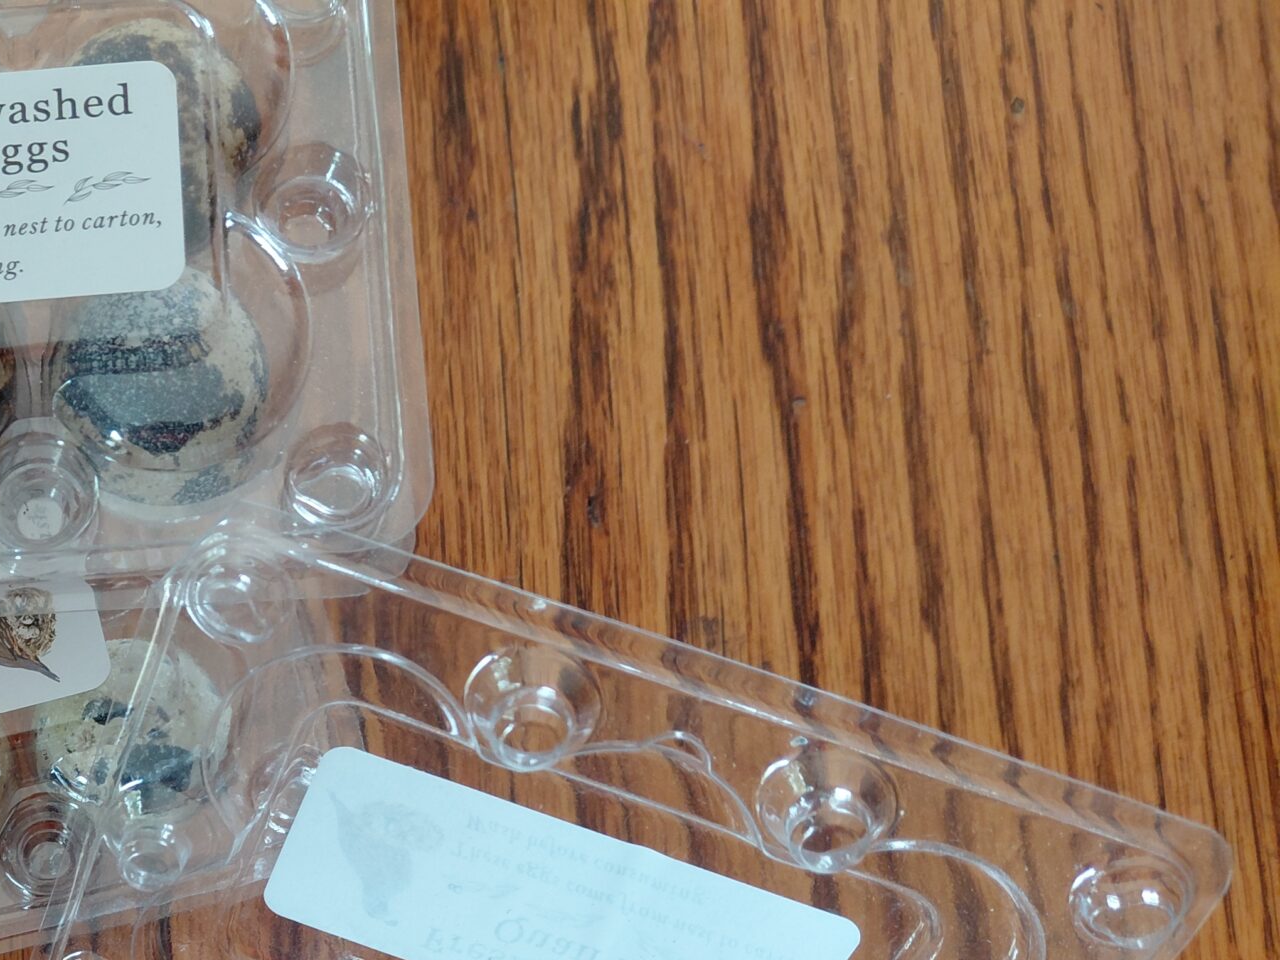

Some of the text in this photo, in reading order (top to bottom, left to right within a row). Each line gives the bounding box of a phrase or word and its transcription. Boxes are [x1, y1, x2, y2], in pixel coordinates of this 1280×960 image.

[2, 216, 49, 237] nest
[53, 215, 76, 233] to
[81, 209, 162, 231] carton,
